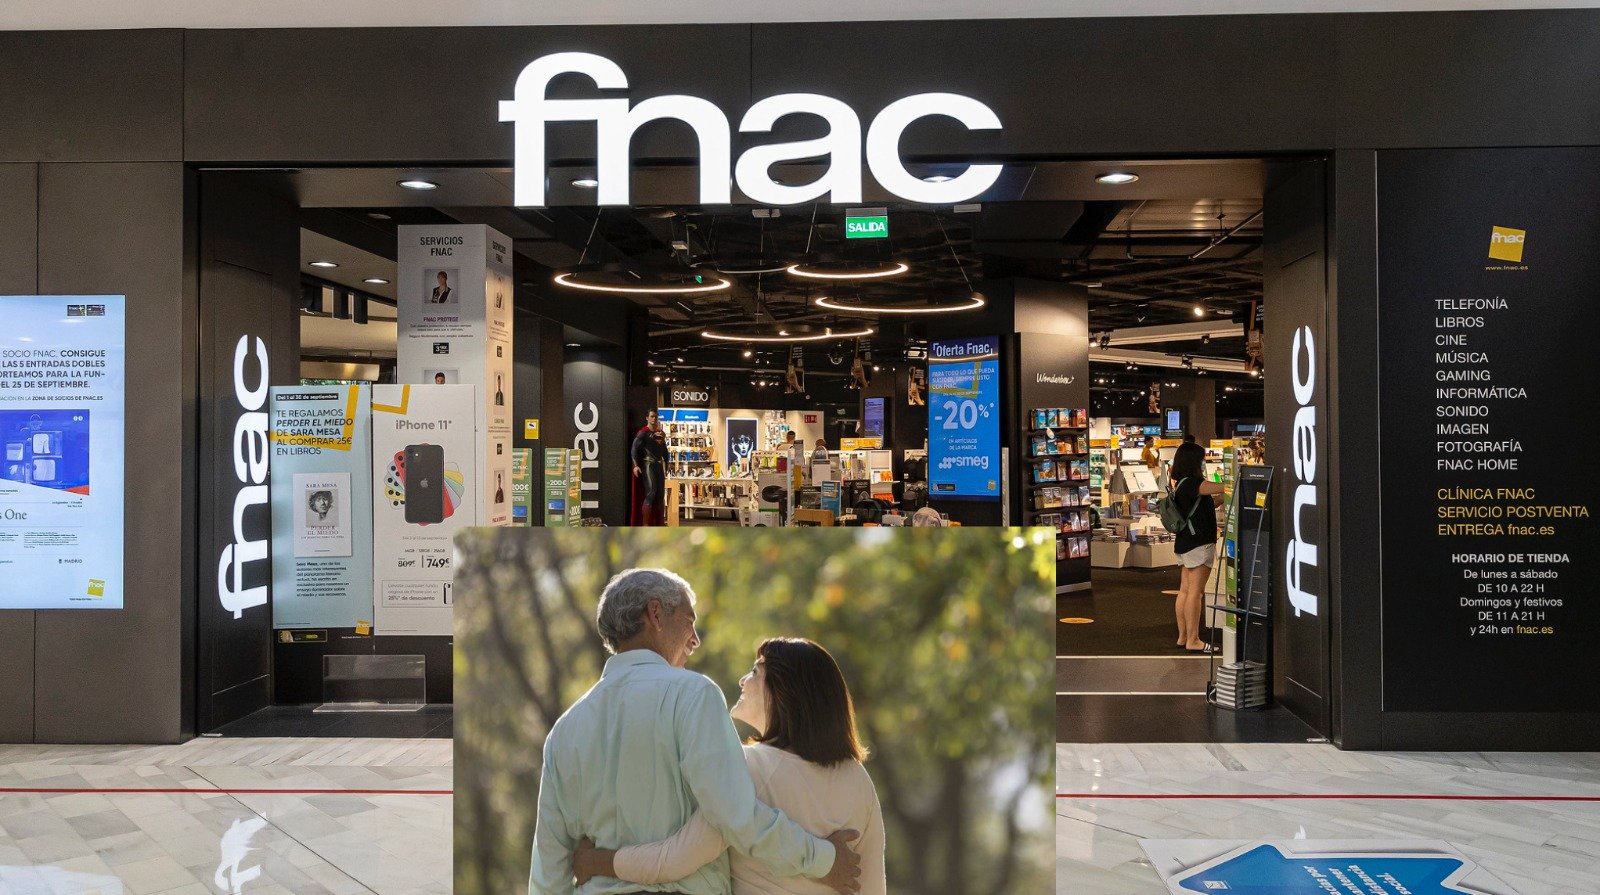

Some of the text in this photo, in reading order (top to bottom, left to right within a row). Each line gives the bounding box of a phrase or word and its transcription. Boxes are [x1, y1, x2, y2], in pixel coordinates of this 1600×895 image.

[498, 51, 1003, 207] fnac
[848, 221, 886, 232] SALIDA
[420, 236, 464, 246] SERVICIOS
[1490, 232, 1525, 244] fnac
[430, 247, 453, 257] FNAC
[1435, 296, 1508, 310] TELEFONÍA
[1435, 316, 1484, 328] LIBROS
[1435, 334, 1467, 346] CINE
[2, 350, 106, 358] SOCIO FNAC, CONSIGUE
[1436, 350, 1488, 364] MÚSICA
[2, 360, 106, 368] LAS 5 ENTRADAS DOBLES
[46, 370, 68, 378] PARA
[71, 370, 81, 378] LA
[84, 370, 105, 378] FUN-
[1436, 370, 1491, 381] GAMING
[673, 391, 708, 402] SONIDO
[1436, 385, 1527, 399] INFORMÁTICA
[289, 409, 343, 417] REGALAMOS
[1436, 405, 1489, 417] SONIDO
[277, 419, 310, 427] PERDER
[324, 418, 353, 426] MIEDO
[395, 420, 436, 431] iPhone
[1436, 424, 1489, 435] IMAGEN
[1437, 439, 1523, 453] FOTOGRAFÍA
[956, 456, 989, 469] smeg
[1437, 459, 1518, 471] FNAC HOME
[1286, 325, 1318, 617] fnac
[218, 334, 269, 620] fnac
[1437, 486, 1535, 500] CLÍNICA FNAC
[4, 508, 27, 520] One
[1437, 506, 1590, 518] SERVICIO POSTVENTA
[1438, 523, 1555, 536] ENTREGA fnac.es
[426, 558, 449, 568] 749€
[1452, 554, 1570, 563] HORARIO DE TIENDA
[1464, 570, 1478, 579] De
[1481, 570, 1508, 579] lunes
[1520, 569, 1558, 579] sábado
[1478, 584, 1544, 593] DE 10 A 22 H
[1460, 597, 1563, 609] Domingos y festivos
[1478, 612, 1545, 620] DE 11 A 21 H
[1470, 627, 1476, 636] y
[1479, 625, 1498, 634] 24h
[1516, 625, 1554, 634] fnac.es
